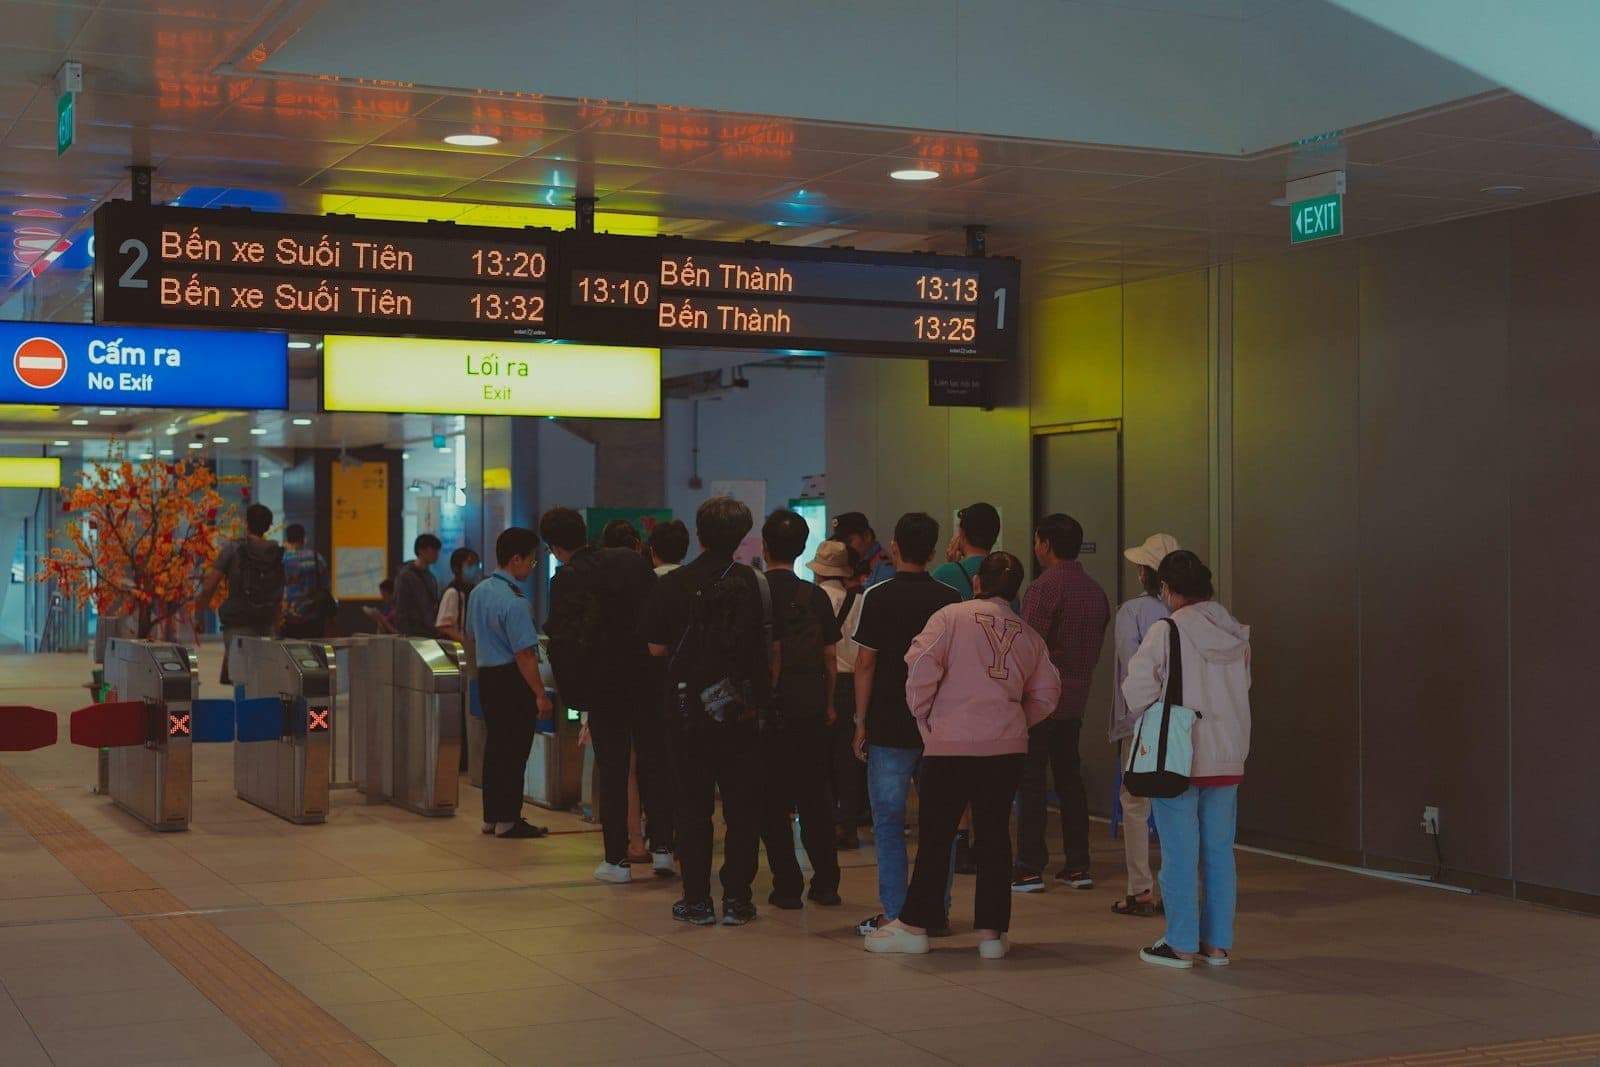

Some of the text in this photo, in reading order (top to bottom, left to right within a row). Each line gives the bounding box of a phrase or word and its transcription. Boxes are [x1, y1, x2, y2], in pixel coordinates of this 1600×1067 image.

[1303, 201, 1338, 236] EXIT
[118, 238, 149, 289] 2
[161, 226, 546, 278] Bến xe Suối Tiên 13:20
[160, 273, 545, 322] Bến xe Suối Tiên 13:32
[578, 277, 649, 305] 13:10
[660, 256, 978, 302] Bến Thành 13:13
[658, 298, 976, 341] Bến Thành 13:25
[993, 287, 1006, 330] 1
[88, 337, 181, 367] Cấm ra
[466, 352, 529, 377] Lối ra
[88, 372, 153, 391] No Exit
[483, 384, 513, 400] Exit
[975, 613, 1022, 681] Y
